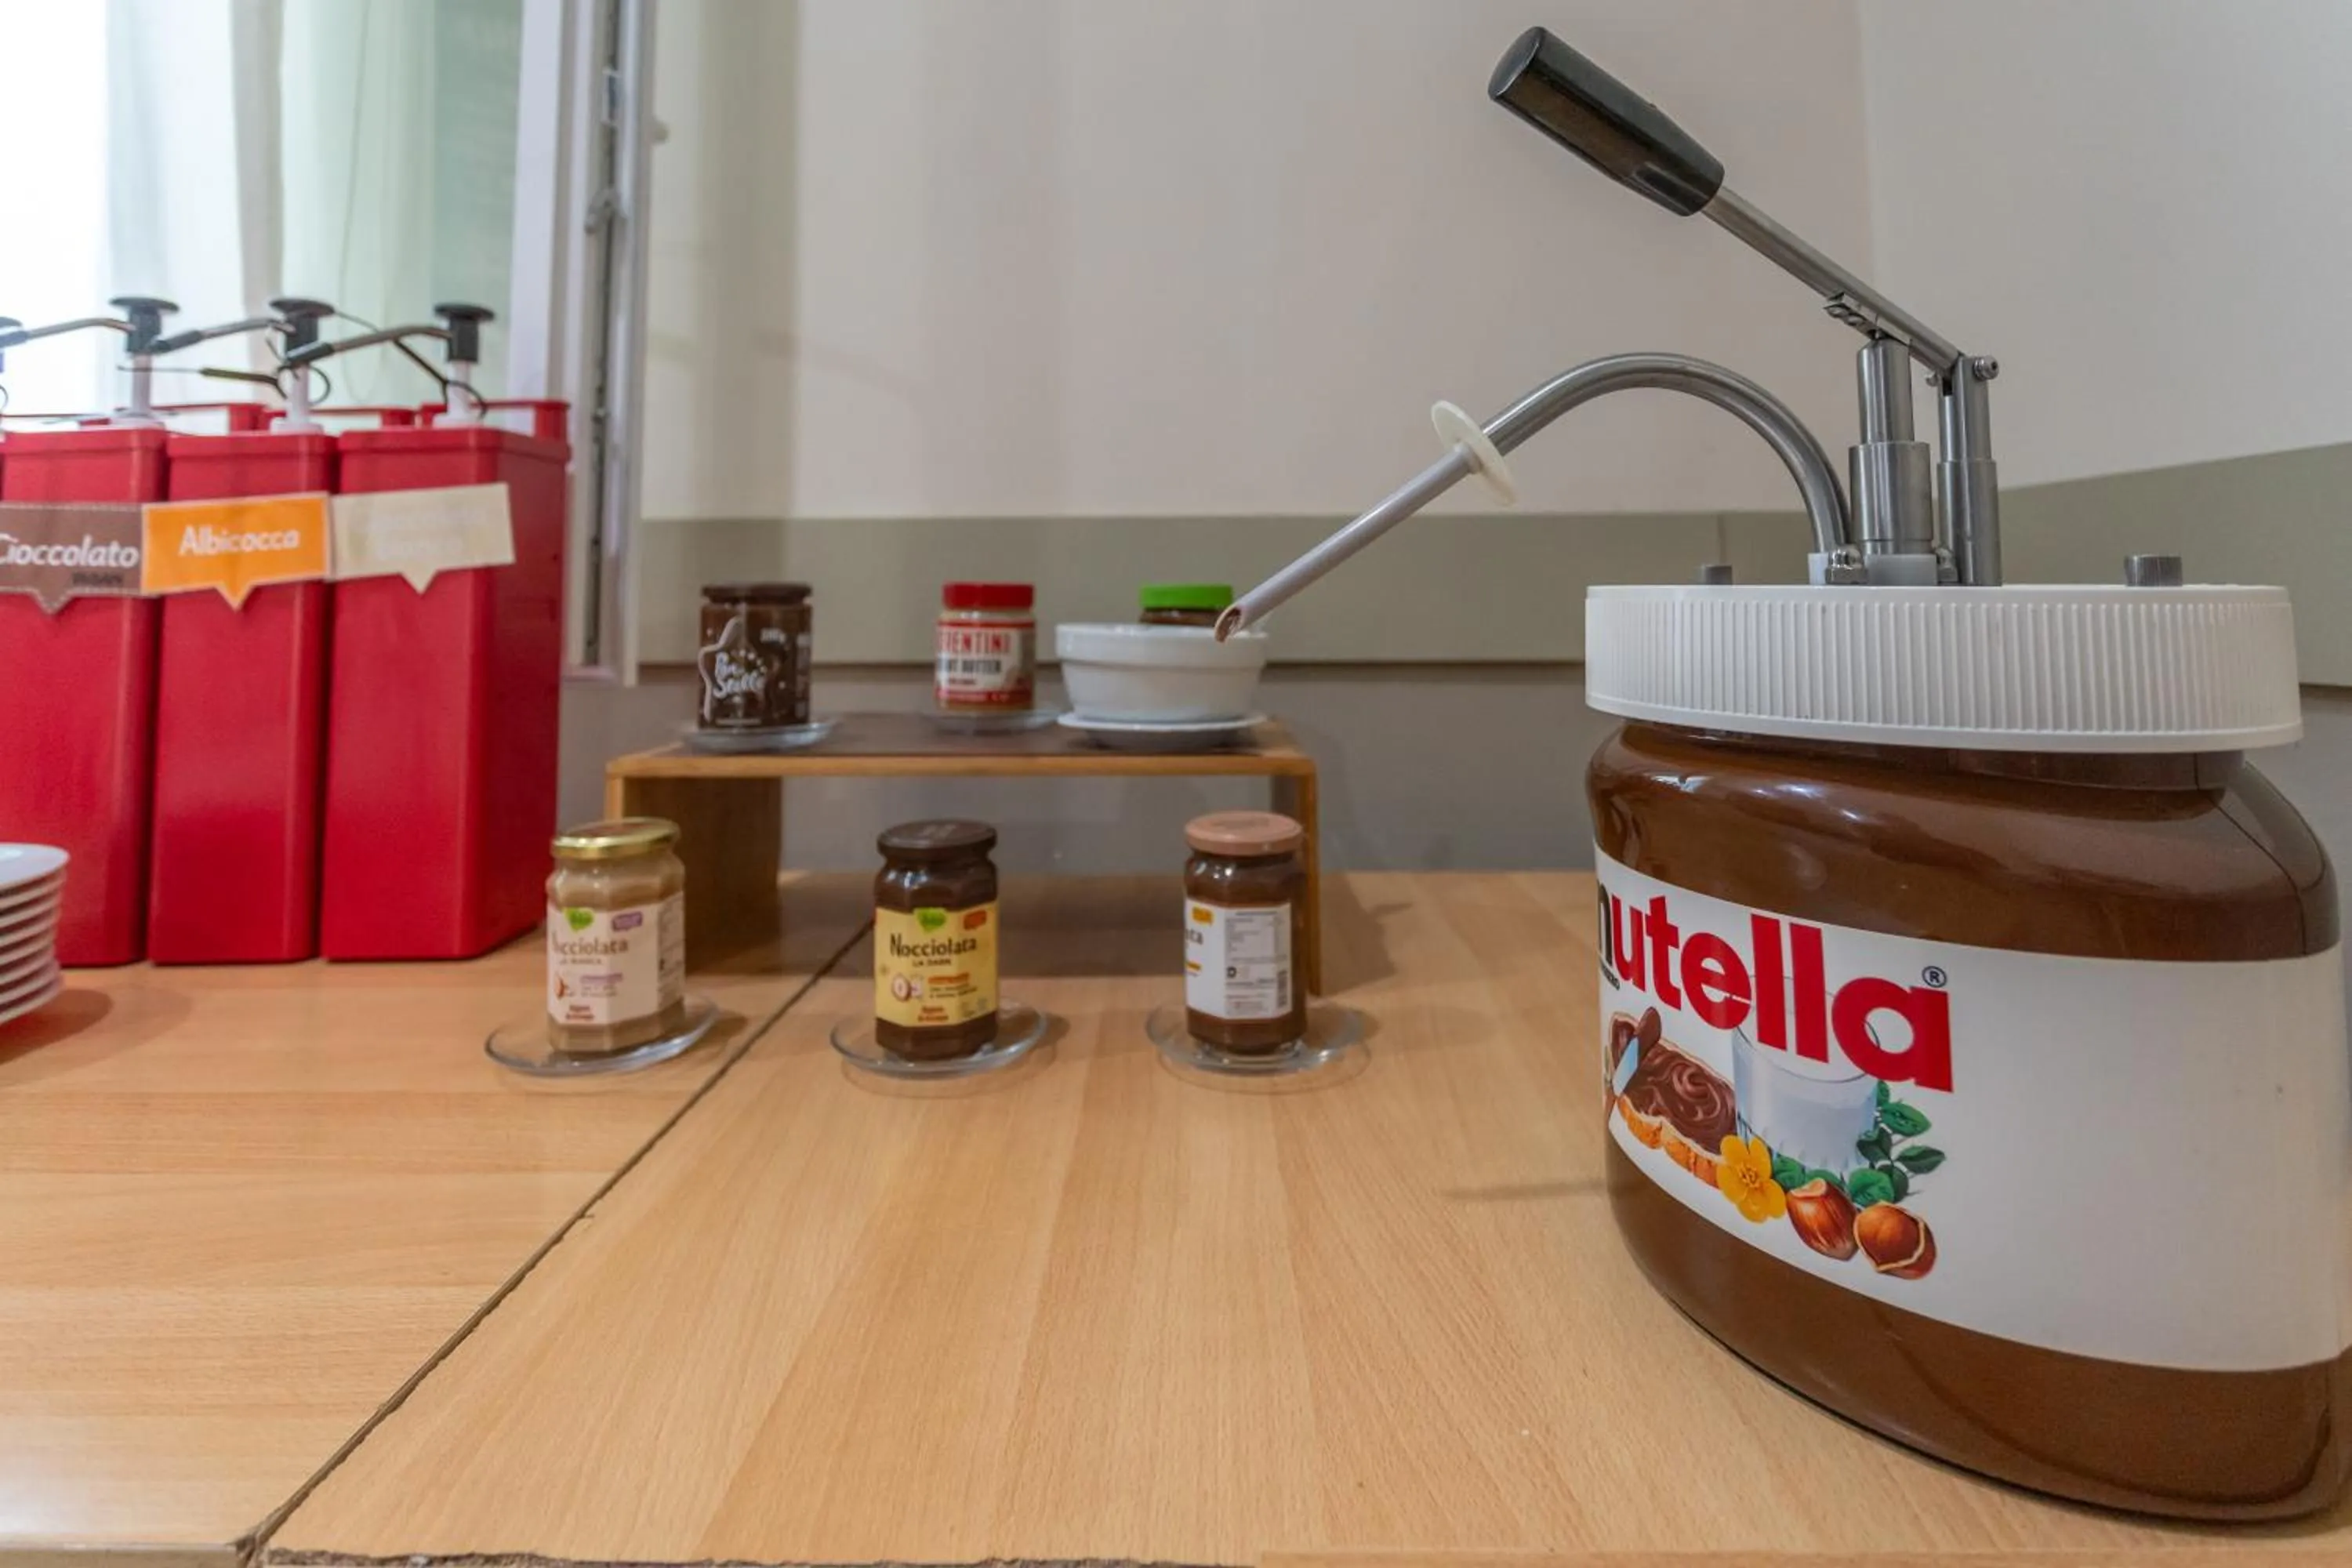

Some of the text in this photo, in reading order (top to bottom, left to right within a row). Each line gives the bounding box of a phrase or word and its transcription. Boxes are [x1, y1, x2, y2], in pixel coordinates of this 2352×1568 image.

[176, 524, 301, 557] Albicocca
[890, 933, 978, 958] Nocciolata
[1597, 879, 1954, 1093] nutella
